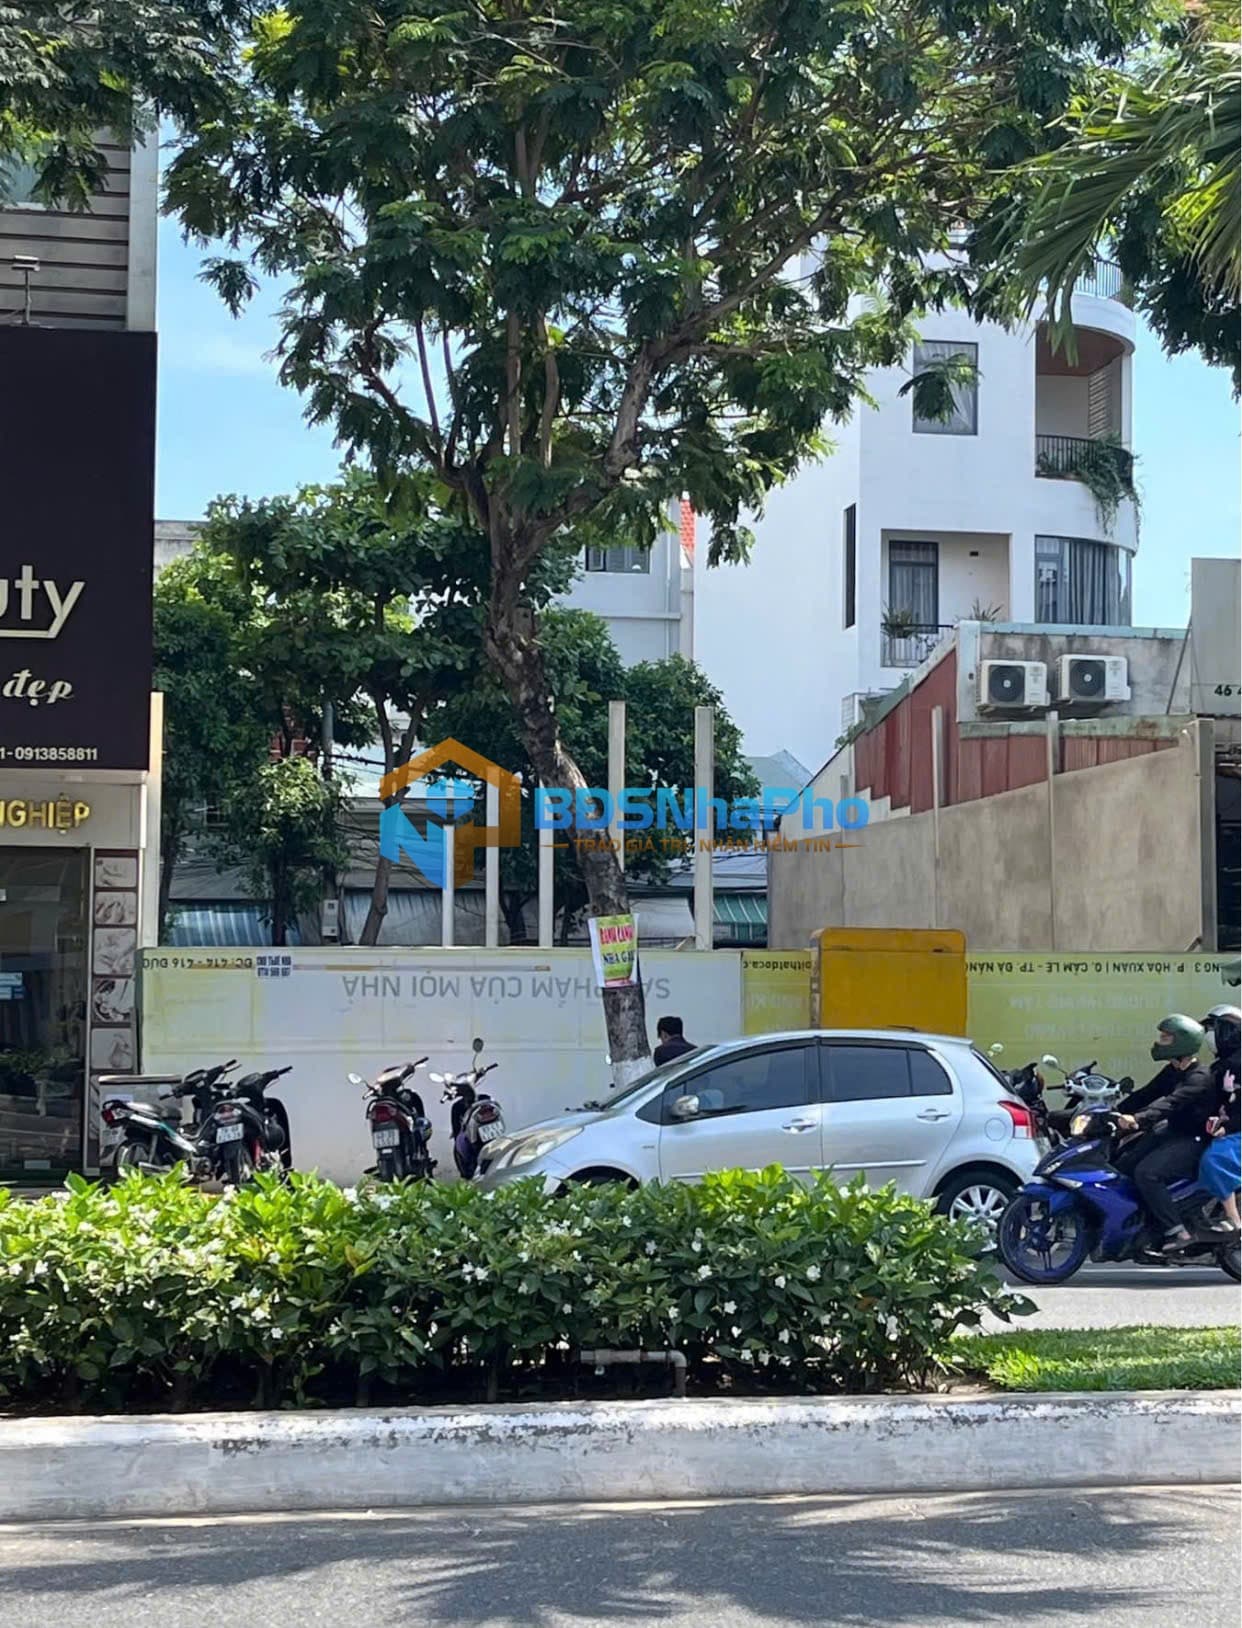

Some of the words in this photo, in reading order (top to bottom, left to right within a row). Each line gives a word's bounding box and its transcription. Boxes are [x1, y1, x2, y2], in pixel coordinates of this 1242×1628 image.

[0, 565, 85, 638] ty
[3, 669, 73, 706] đẹp
[172, 958, 193, 968] 416
[470, 976, 522, 1004] CỦA
